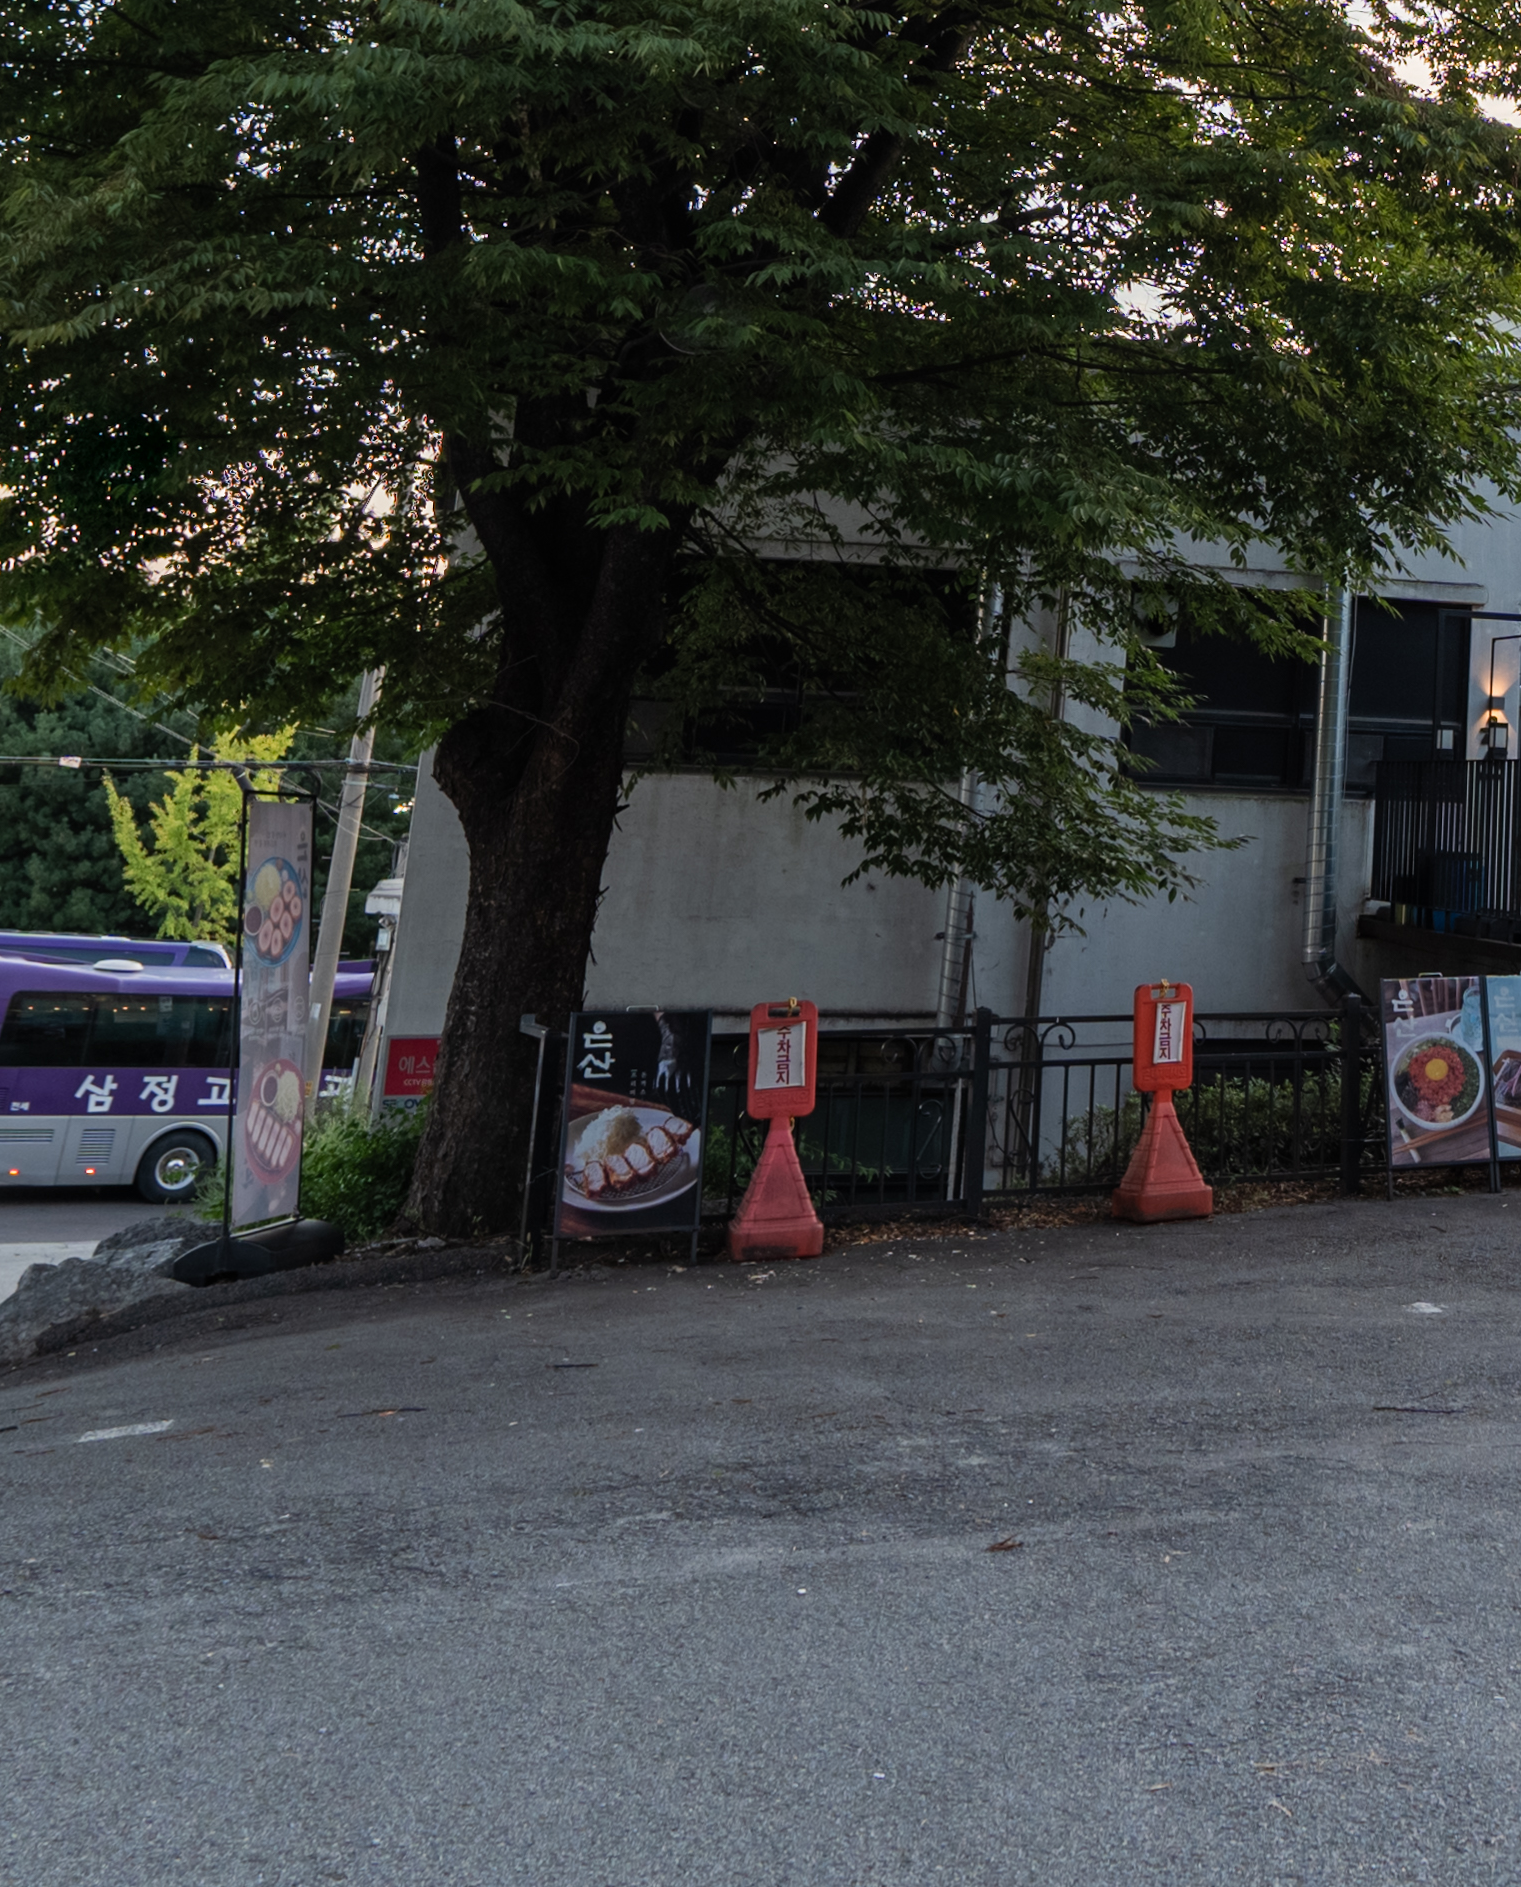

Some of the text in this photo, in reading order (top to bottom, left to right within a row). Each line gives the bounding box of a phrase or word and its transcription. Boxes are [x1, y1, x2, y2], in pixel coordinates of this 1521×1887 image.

[1159, 1004, 1172, 1060] 주차금지
[1391, 989, 1416, 1038] 은산
[576, 1020, 616, 1079] 은산
[776, 1026, 791, 1085] 주차금지
[403, 1078, 421, 1086] CCTV
